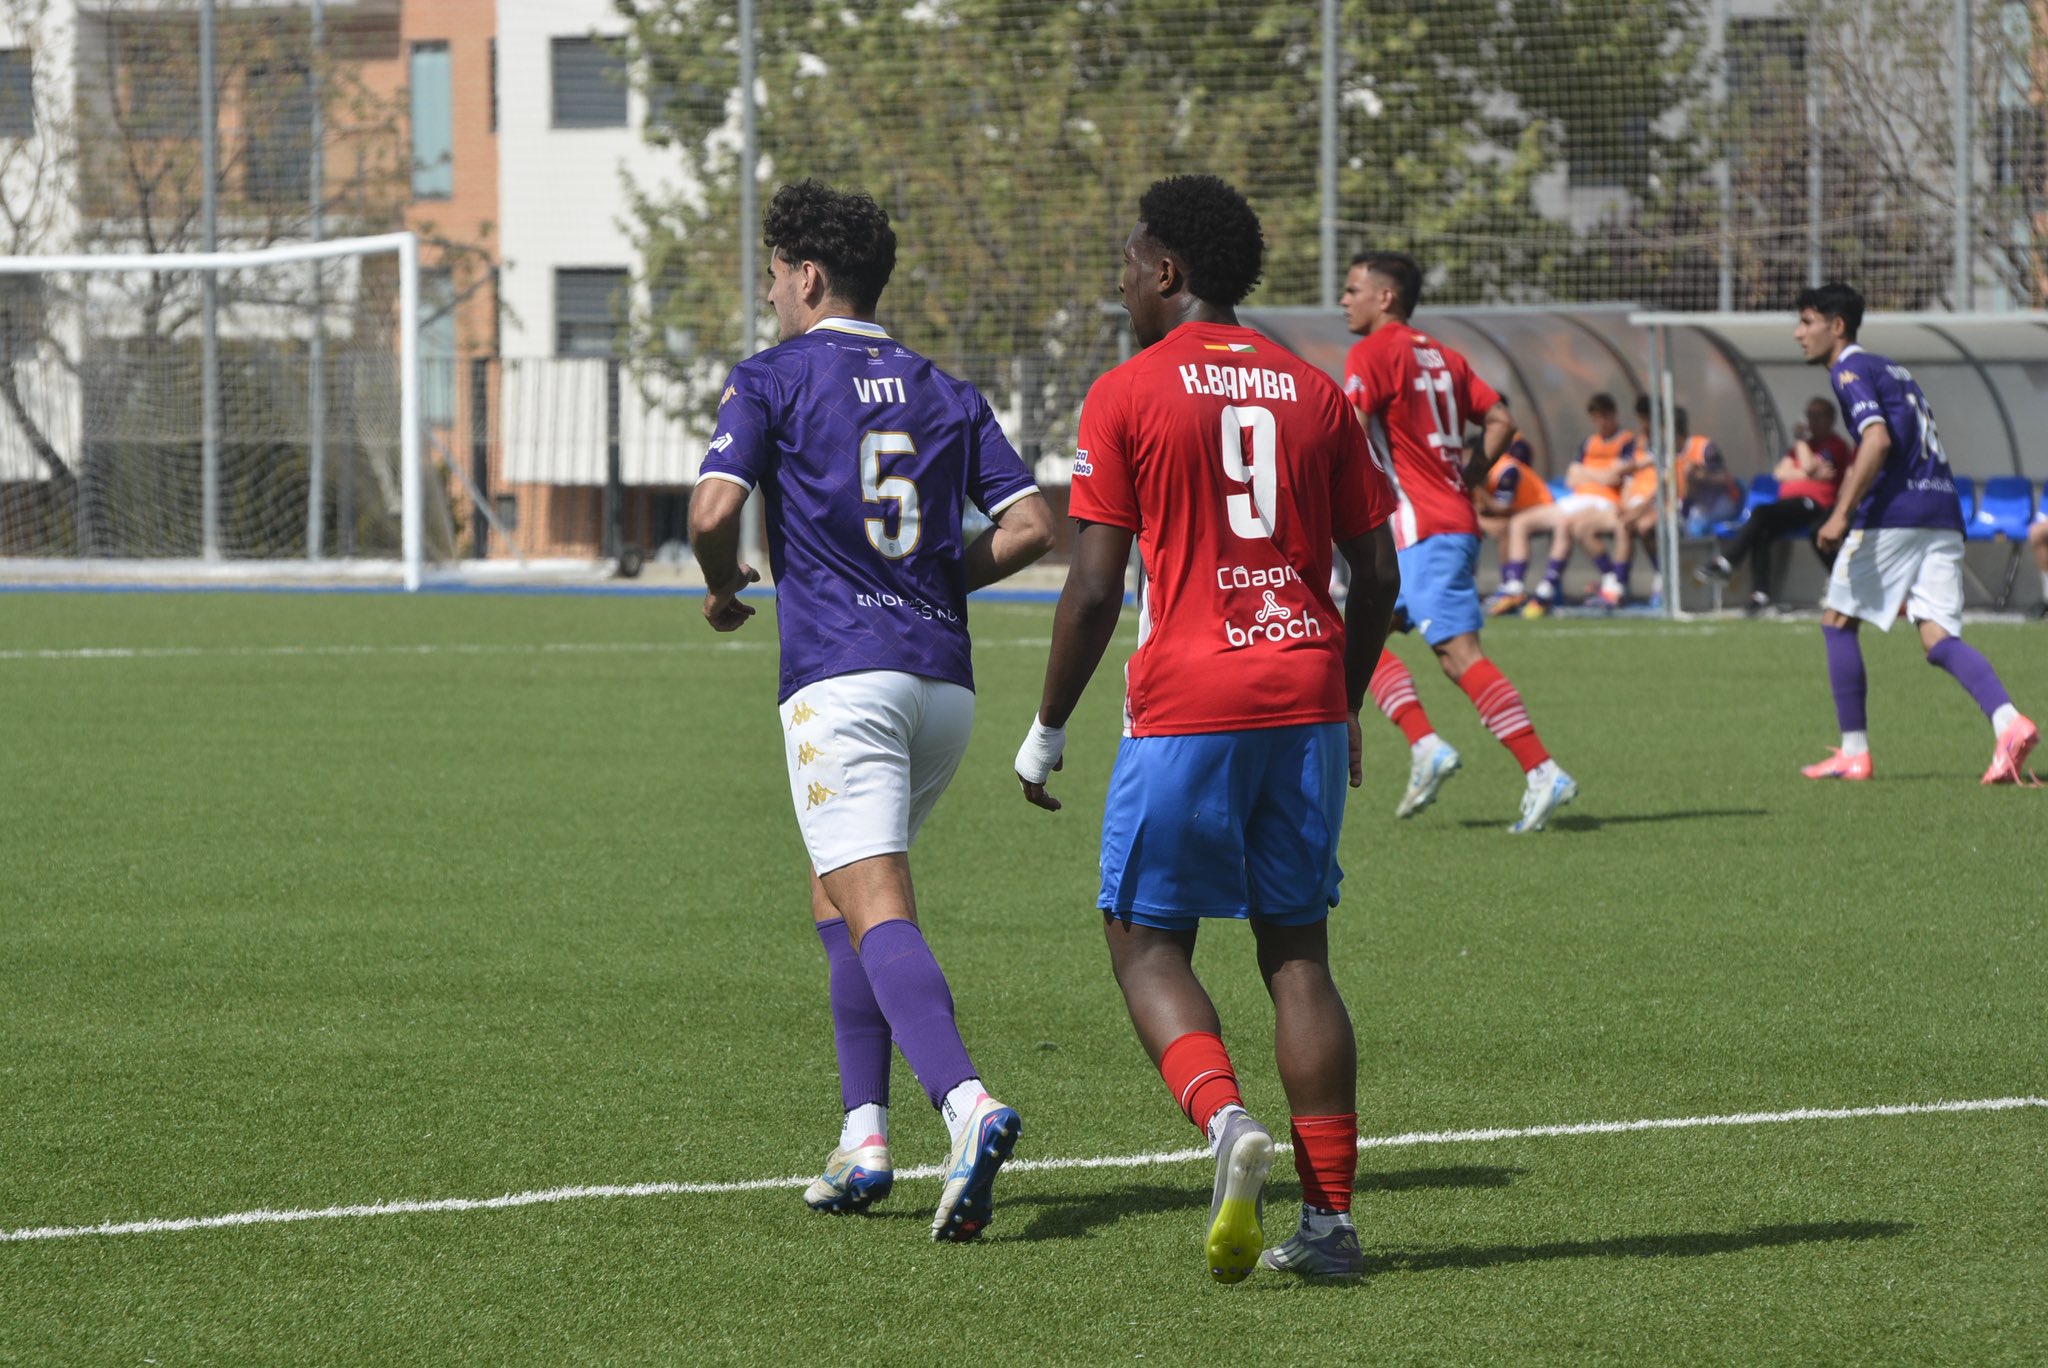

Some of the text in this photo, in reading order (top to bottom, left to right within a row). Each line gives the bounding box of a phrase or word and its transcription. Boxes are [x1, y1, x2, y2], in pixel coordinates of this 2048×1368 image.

[853, 377, 906, 402] VITI
[1180, 364, 1298, 401] K.BAMBA
[1413, 370, 1461, 447] 11
[859, 431, 920, 559] 5
[1222, 406, 1277, 538] 9
[1225, 604, 1321, 647] broch
